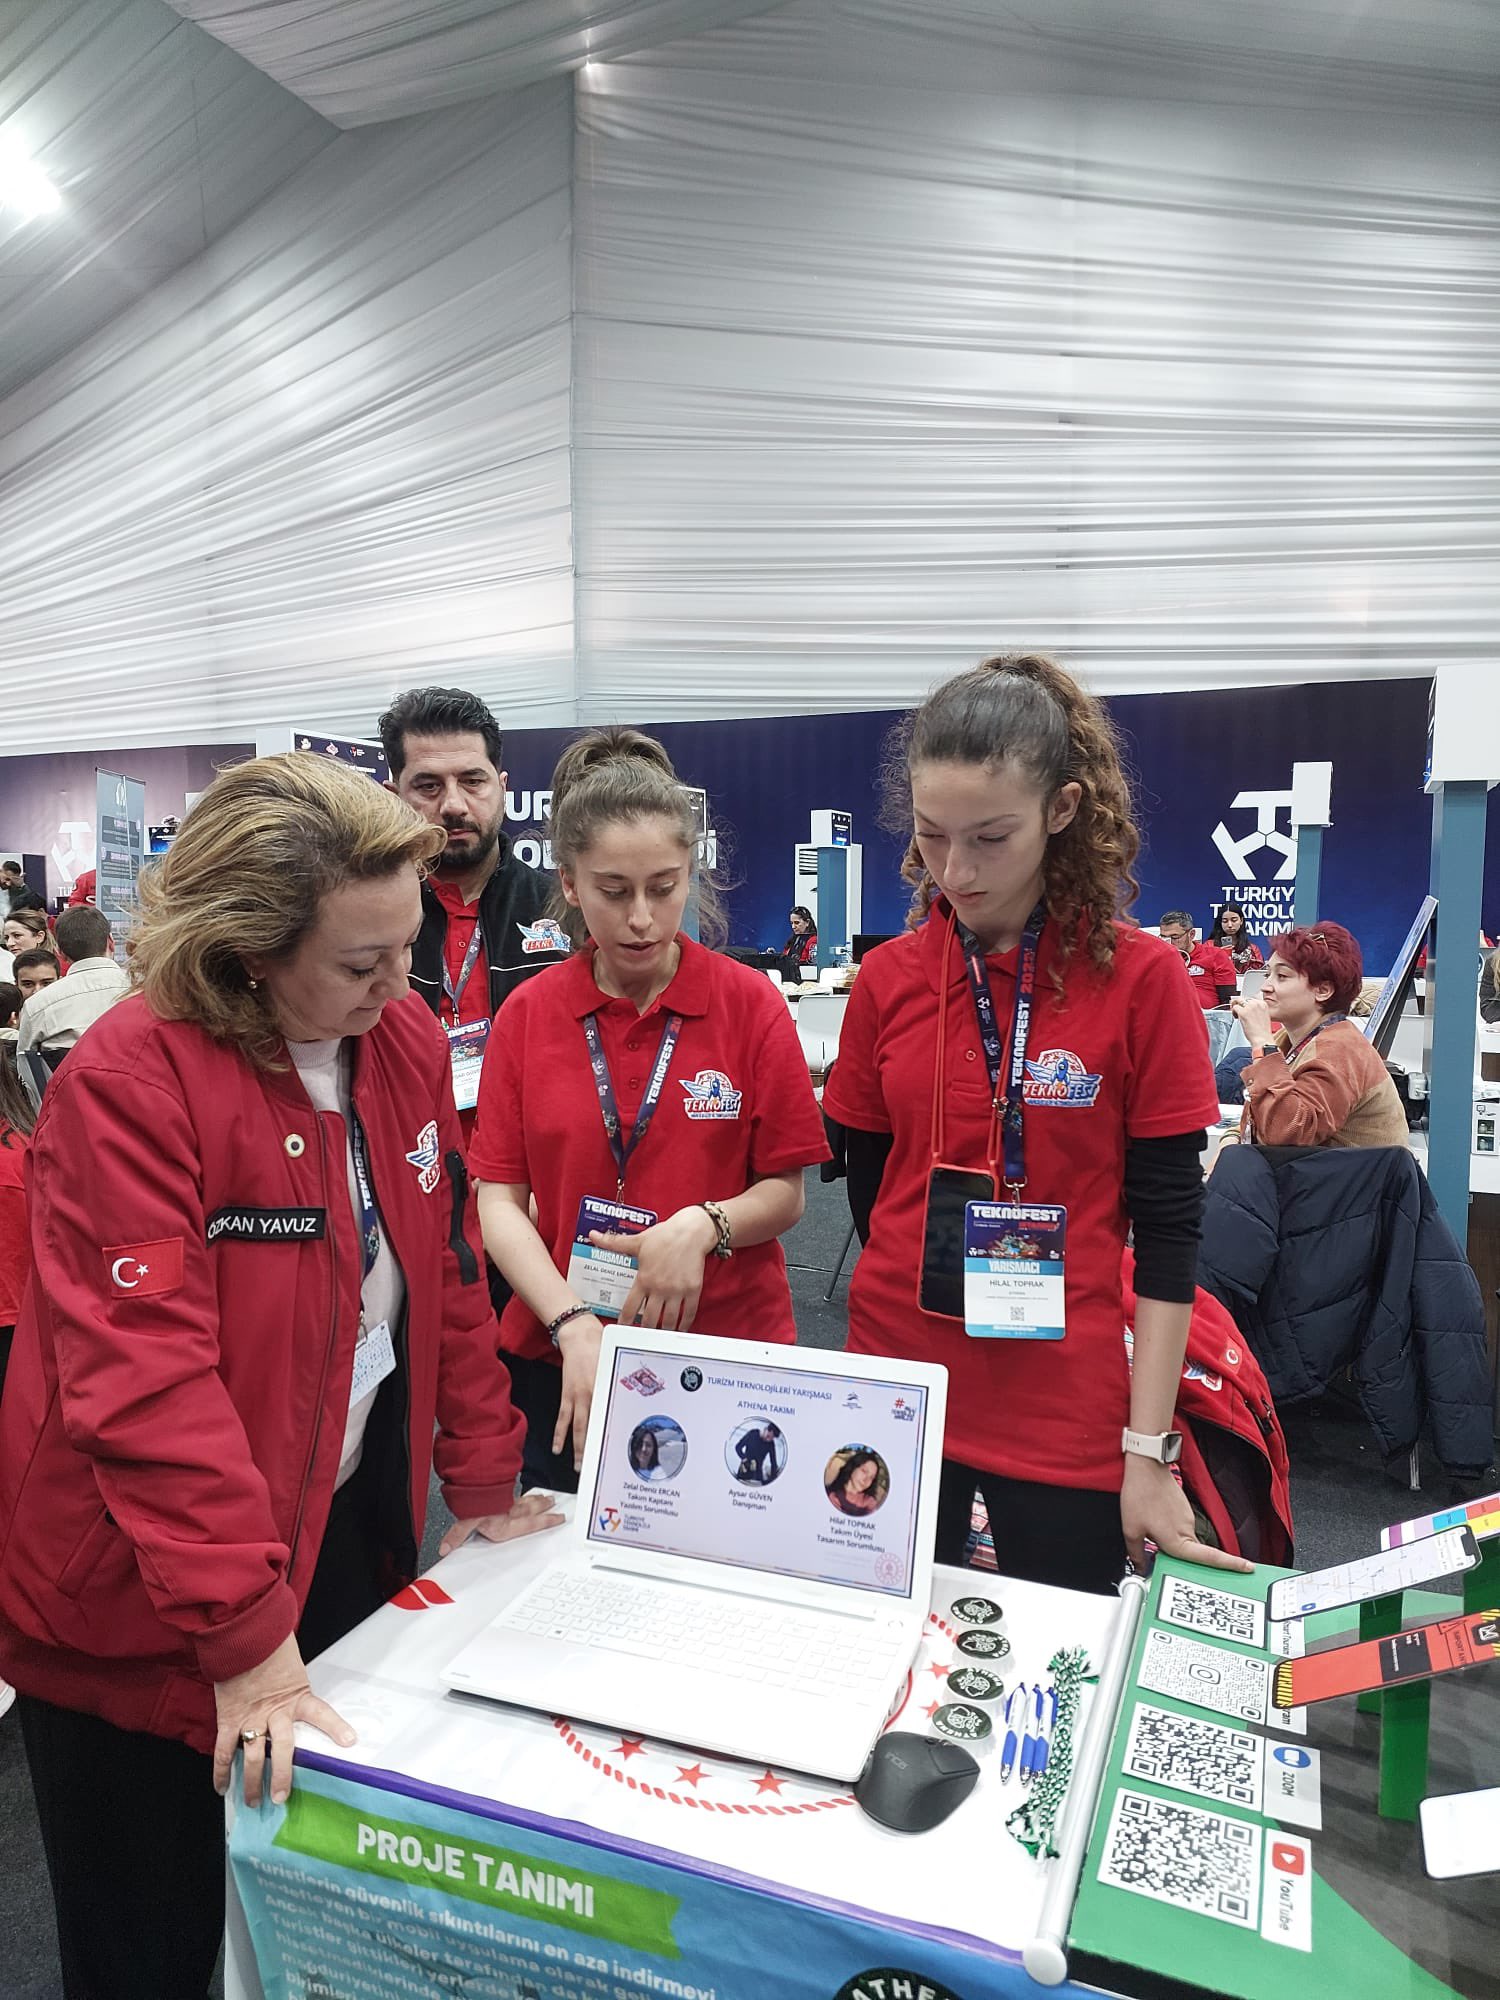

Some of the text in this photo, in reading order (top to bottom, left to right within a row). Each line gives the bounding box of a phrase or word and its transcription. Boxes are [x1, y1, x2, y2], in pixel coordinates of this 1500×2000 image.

[1221, 886, 1296, 902] TÜRKİY
[1011, 1000, 1030, 1087] TEKNOFEST
[645, 1015, 682, 1105] TEKNOFEST 20
[1022, 1084, 1098, 1099] TEKNOFEST
[685, 1098, 740, 1112] TEKNOFEST
[583, 1199, 655, 1226] TEKNOFEST
[971, 1205, 1060, 1221] TEKNOFEST
[258, 1217, 318, 1235] YAVUZ
[707, 1376, 833, 1401] TURİZM TEKNOLOJİLERİ YARIŞMASI
[737, 1400, 796, 1415] ATHENA TAKIMI
[658, 1488, 680, 1498] ERCAN
[847, 1519, 876, 1531] TOPRAK
[1281, 1770, 1297, 1798] ZOOM
[357, 1822, 595, 1919] PROJE TANIMI
[249, 1855, 342, 1895] Turistlerin
[343, 1885, 425, 1920] güvenlik
[428, 1908, 540, 1953] sıkıntılarını
[543, 1943, 570, 1961] en
[573, 1951, 609, 1974] aza
[1278, 1879, 1295, 1931] YouTube
